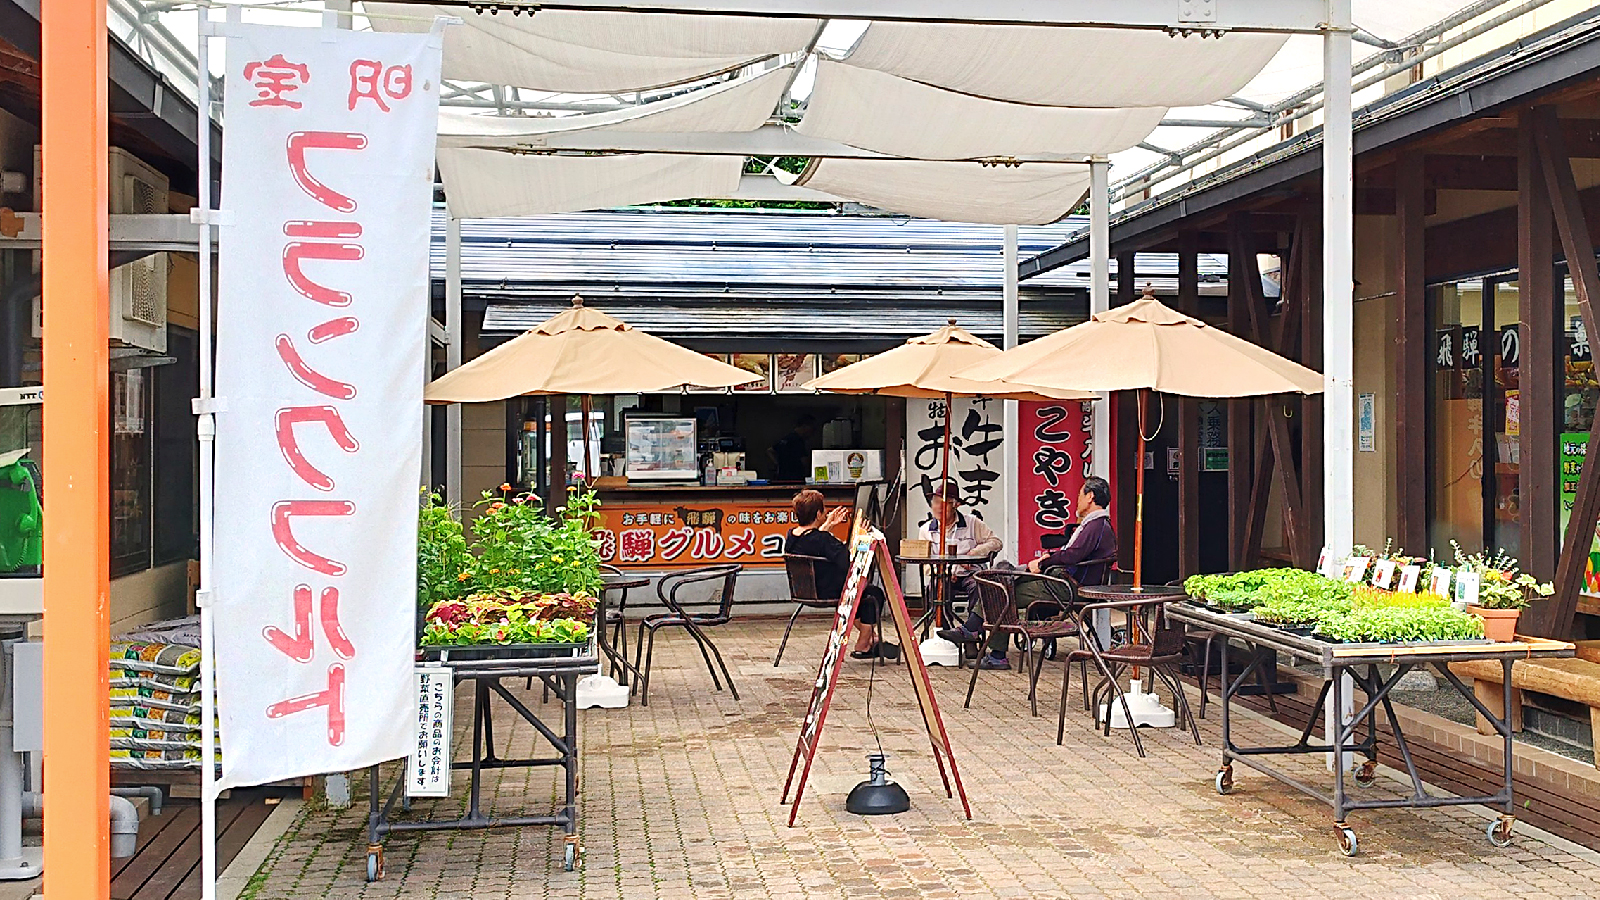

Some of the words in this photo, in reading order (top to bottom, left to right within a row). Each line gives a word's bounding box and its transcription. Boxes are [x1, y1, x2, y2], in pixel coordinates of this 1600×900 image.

[416, 673, 430, 790] 野菜直売所でお願いします。
[431, 682, 443, 782] こちらの商品のお会計は
